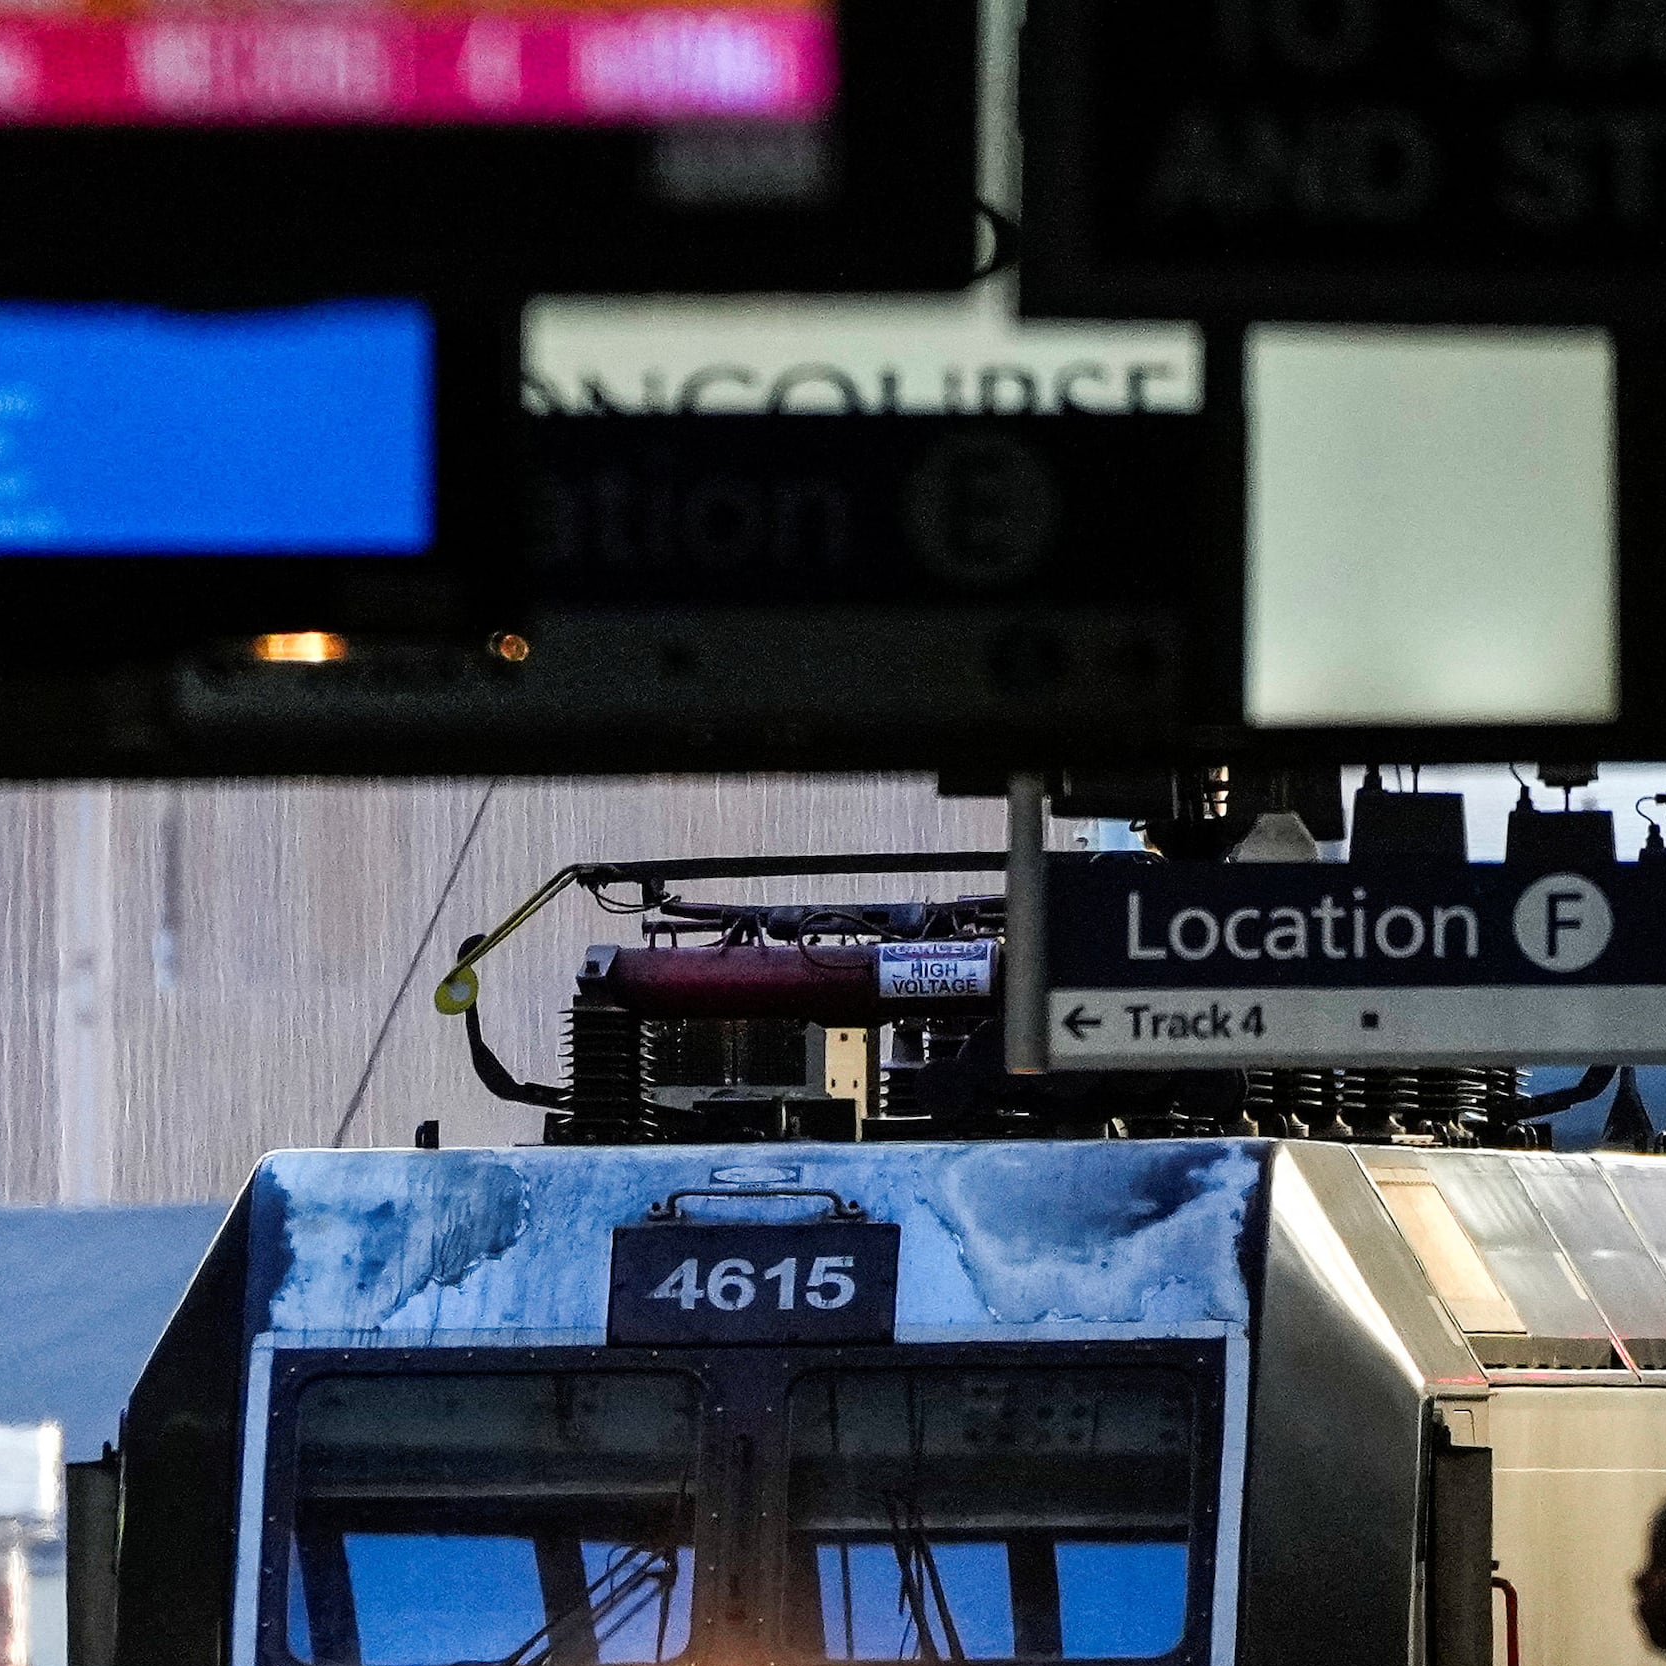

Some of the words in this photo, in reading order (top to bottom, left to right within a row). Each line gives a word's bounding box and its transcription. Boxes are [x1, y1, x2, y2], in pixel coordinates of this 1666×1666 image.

[1153, 103, 1437, 220] AND
[1126, 886, 1480, 961] Location
[1546, 892, 1584, 959] F
[893, 979, 978, 994] VOLTAGE
[910, 963, 958, 978] HIGH
[1125, 1003, 1231, 1040] Track
[1241, 1004, 1265, 1037] 4
[643, 1255, 856, 1312] 4615
